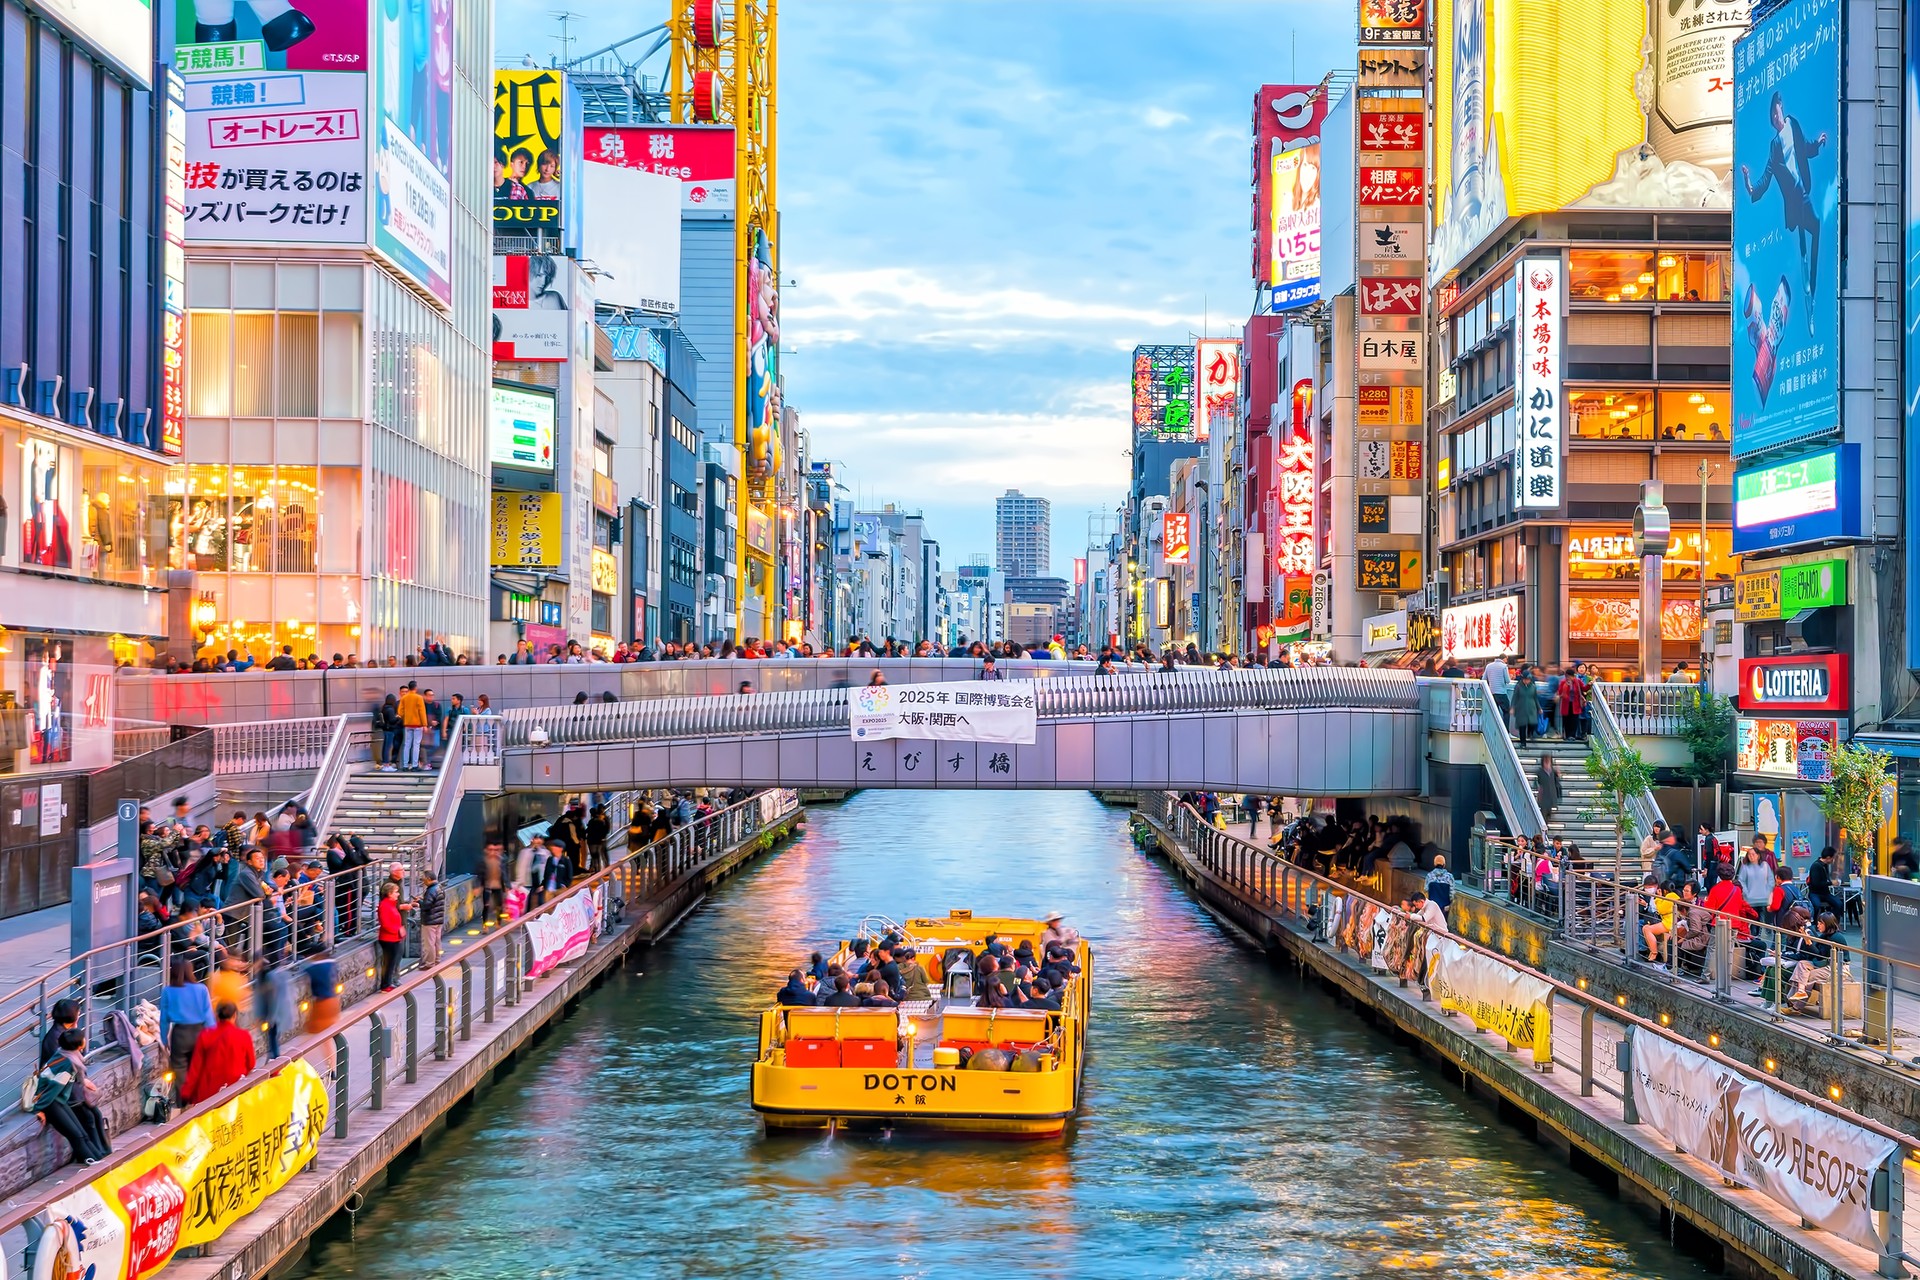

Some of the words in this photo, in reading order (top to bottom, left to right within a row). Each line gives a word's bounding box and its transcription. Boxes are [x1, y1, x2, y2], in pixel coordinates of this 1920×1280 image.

[1364, 27, 1381, 40] 9F
[1382, 30, 1422, 40] 全室個室
[211, 82, 267, 106] 競輪！
[222, 114, 345, 143] オートレース！
[599, 133, 675, 159] 免税
[1370, 169, 1398, 185] 相席
[1361, 184, 1423, 203] ダイニング
[1373, 263, 1390, 275] 5F
[1362, 281, 1421, 313] はや
[1363, 337, 1418, 359] 白木屋
[1530, 298, 1552, 379] 本場の味
[1528, 386, 1554, 499] かに道楽
[1760, 463, 1809, 495] 大阪ニュース
[1277, 436, 1314, 575] 大阪王将
[1363, 505, 1385, 515] びっくり
[1362, 513, 1386, 524] ドンキー
[1165, 520, 1176, 551] ドラッグ
[1176, 516, 1187, 544] ツルハ
[1363, 559, 1396, 574] びっくり
[1361, 572, 1398, 586] ドンキー
[1314, 587, 1324, 611] ZERO
[1766, 668, 1823, 697] LOTTERIA
[898, 691, 950, 705] 2025年
[955, 692, 1035, 709] 国際博覧会を
[898, 711, 971, 727] 大阪・関西へ
[862, 751, 1011, 774] えびす橋
[1891, 901, 1918, 917] information
[863, 1073, 956, 1092] DOTON
[894, 1093, 927, 1106] 大阪
[1735, 1110, 1787, 1169] MGM
[1791, 1136, 1871, 1212] RESORTS
